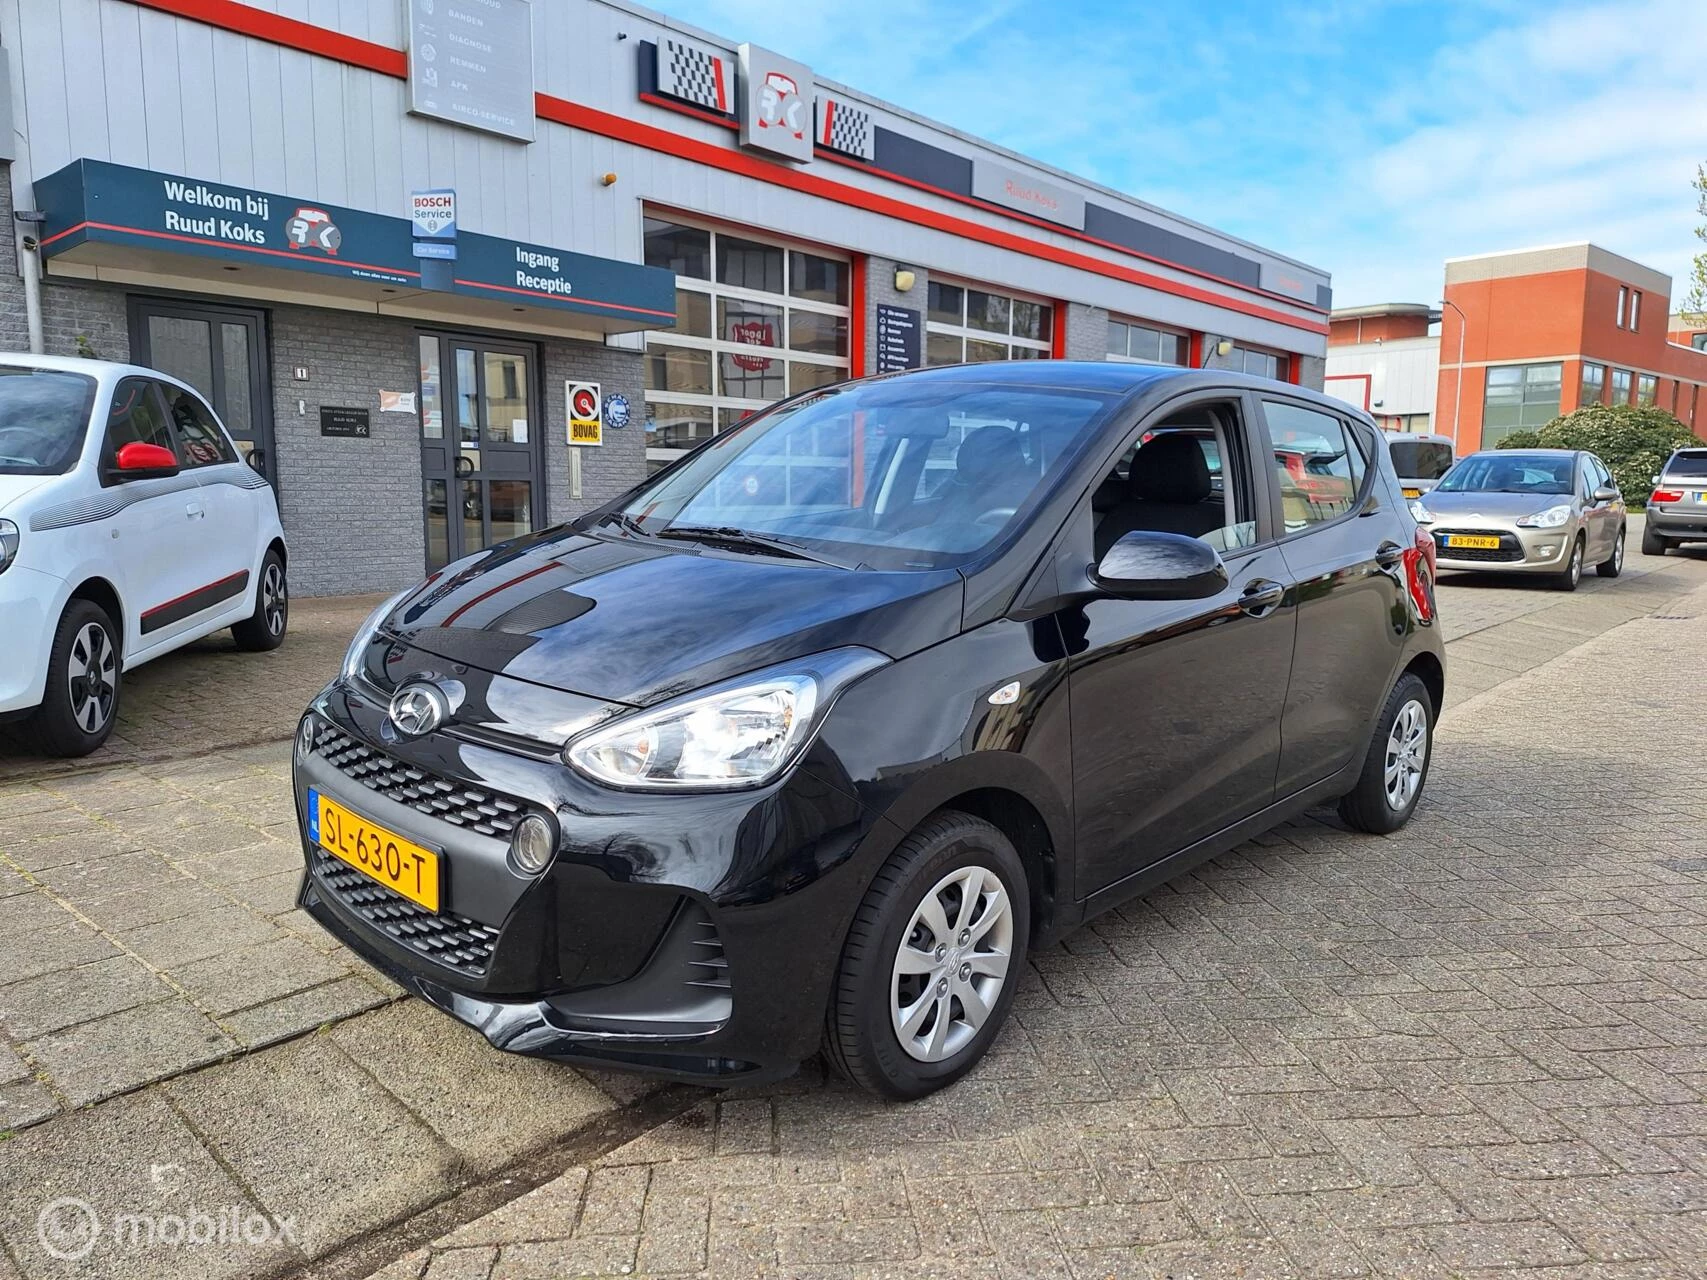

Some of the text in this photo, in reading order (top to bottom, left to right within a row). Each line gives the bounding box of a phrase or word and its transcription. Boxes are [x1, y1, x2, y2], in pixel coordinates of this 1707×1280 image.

[448, 9, 484, 27] BANDEN
[448, 32, 492, 53] DIAGNOSE
[449, 56, 487, 73] REMMEN
[450, 80, 469, 91] APK
[164, 180, 270, 221] Welkom bij
[414, 196, 451, 207] BOSCH
[414, 208, 452, 219] Service
[165, 210, 266, 244] Ruud Koks
[516, 246, 559, 272] Ingang
[516, 270, 572, 294] Receptie
[573, 423, 598, 439] BOVAG
[1451, 537, 1496, 547] 83-PNR-6
[325, 807, 427, 894] SL-630-T
